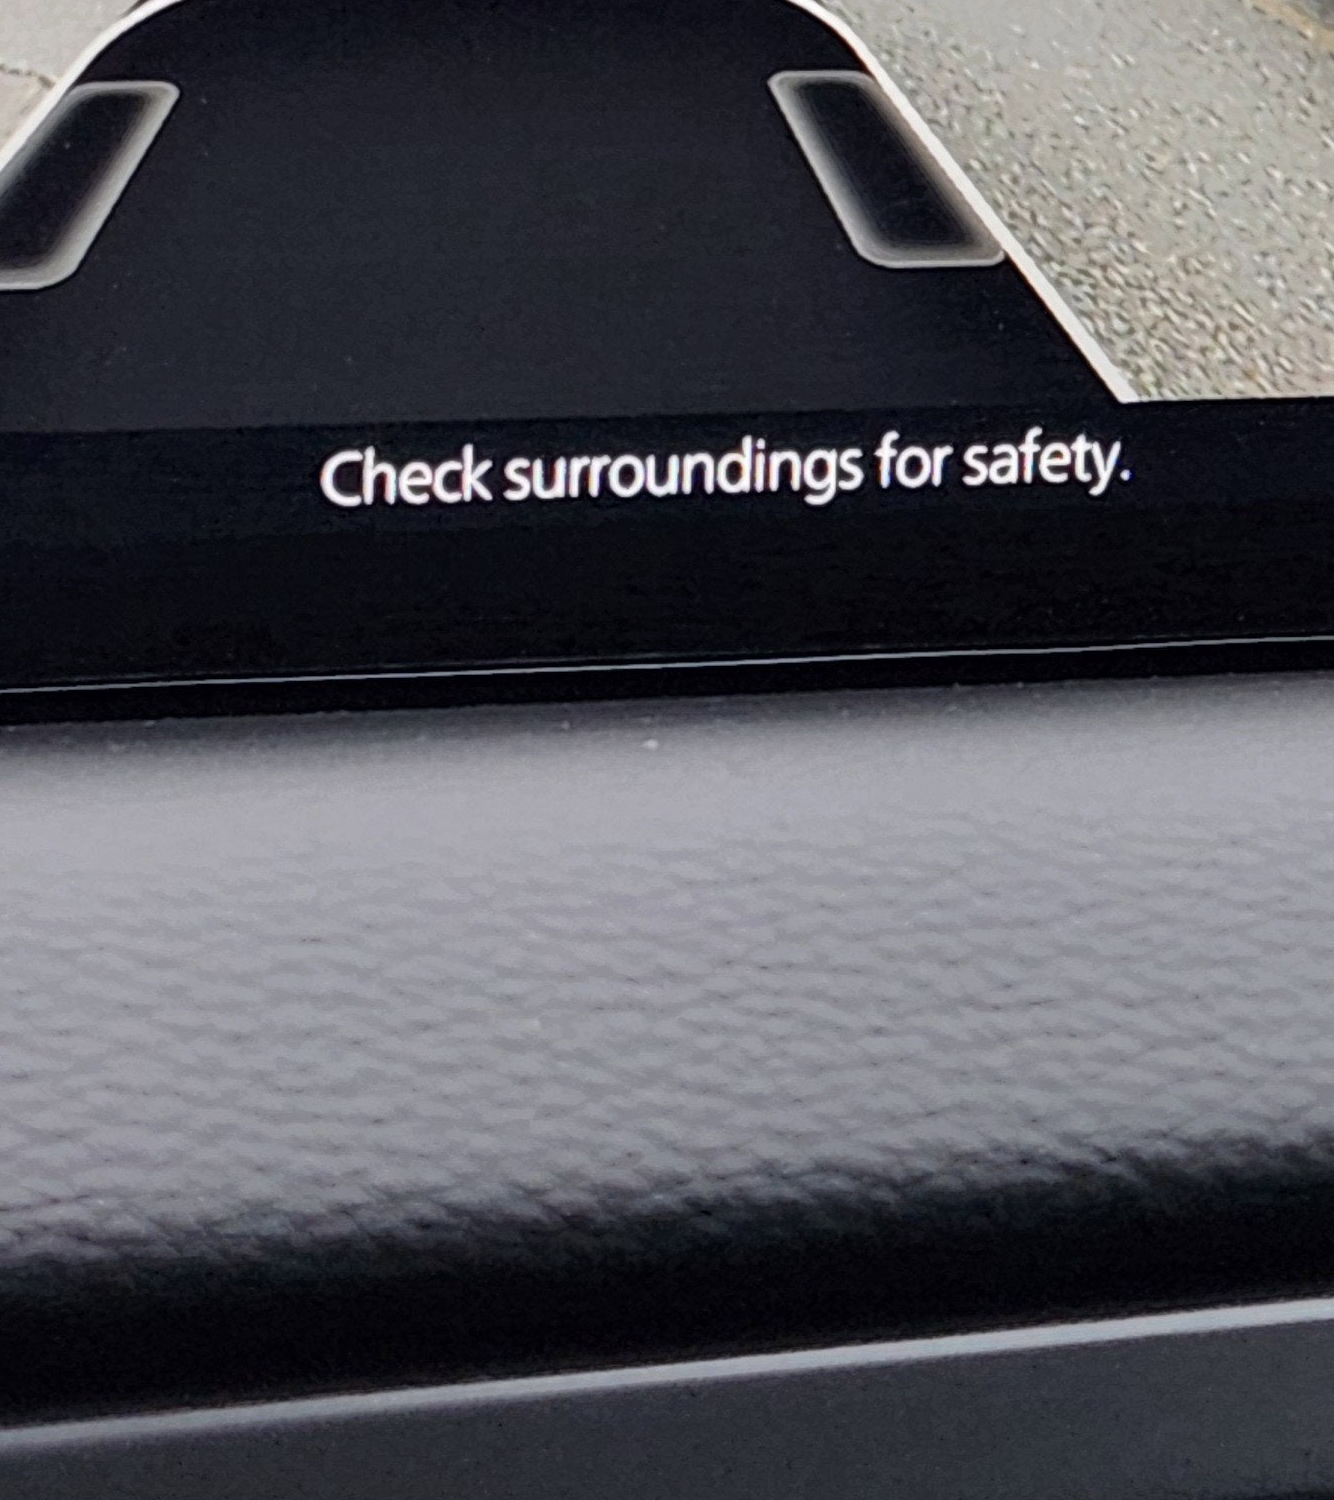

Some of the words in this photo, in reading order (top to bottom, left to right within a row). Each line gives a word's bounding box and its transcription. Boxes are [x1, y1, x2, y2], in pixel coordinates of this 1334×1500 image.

[321, 444, 492, 507] Check
[504, 436, 864, 506] surroundings
[874, 431, 954, 489] for
[963, 427, 1134, 496] safety.
